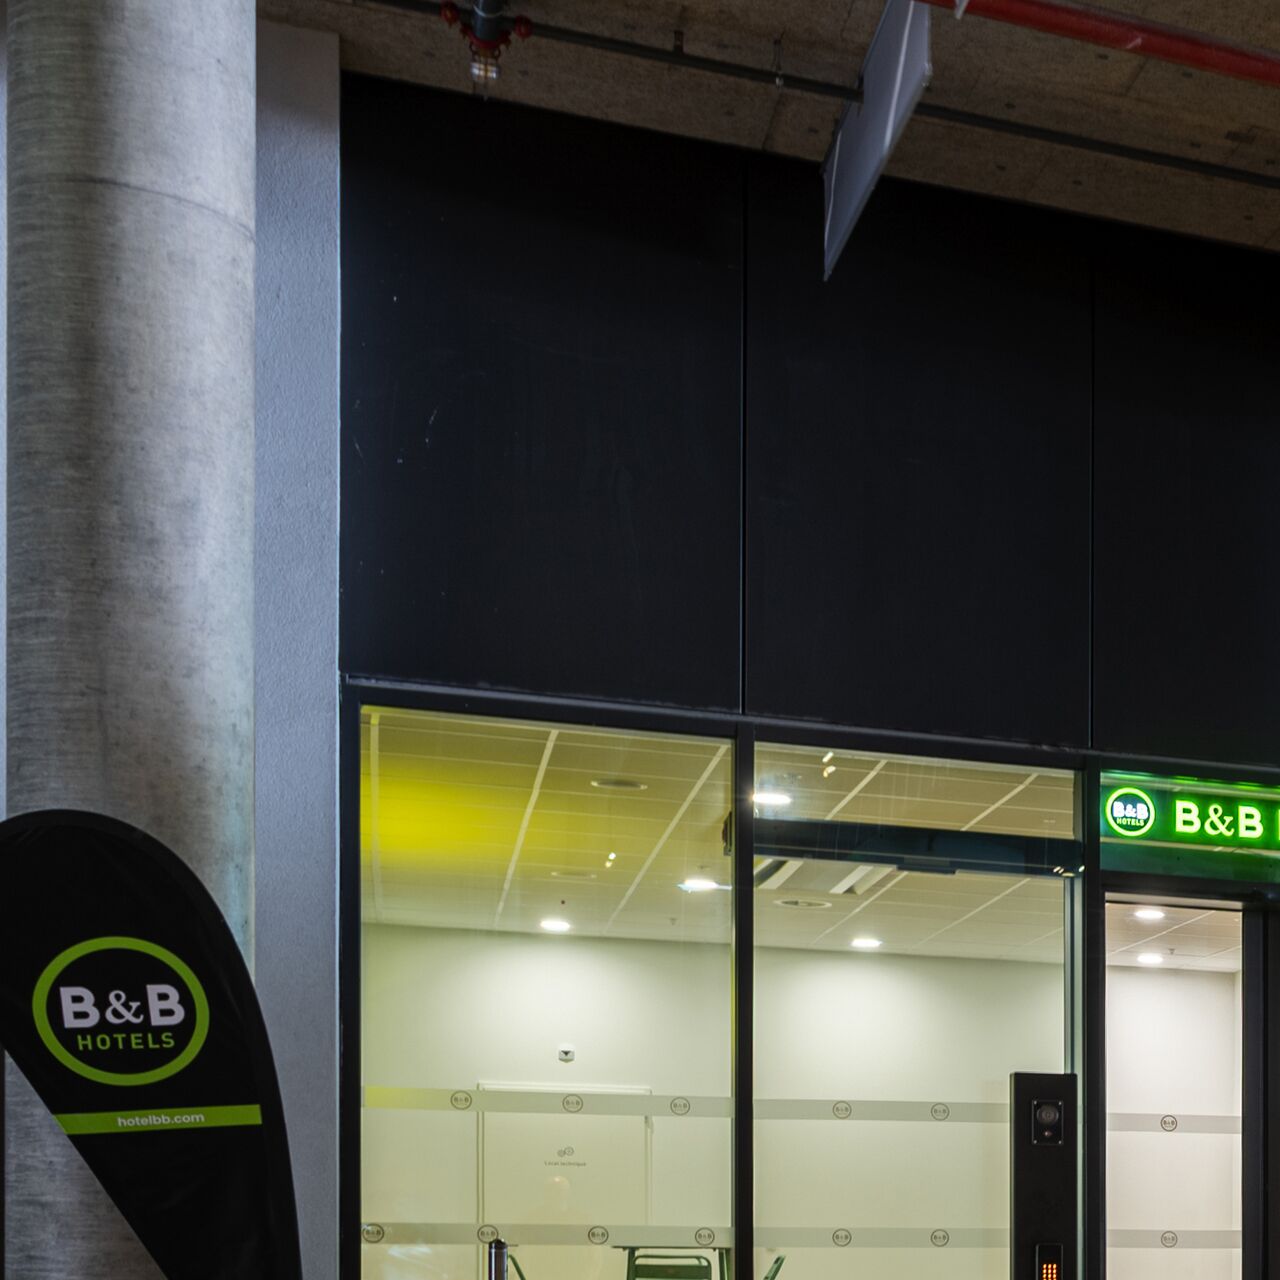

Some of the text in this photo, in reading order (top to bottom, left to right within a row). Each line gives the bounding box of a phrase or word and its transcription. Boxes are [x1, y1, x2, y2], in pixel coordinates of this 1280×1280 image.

[1113, 801, 1149, 820] B&B
[1175, 799, 1264, 839] B&B
[1116, 817, 1145, 826] HOTELS
[59, 983, 185, 1029] B&B
[77, 1031, 176, 1051] HOTELS
[117, 1111, 206, 1127] hotelbb.com
